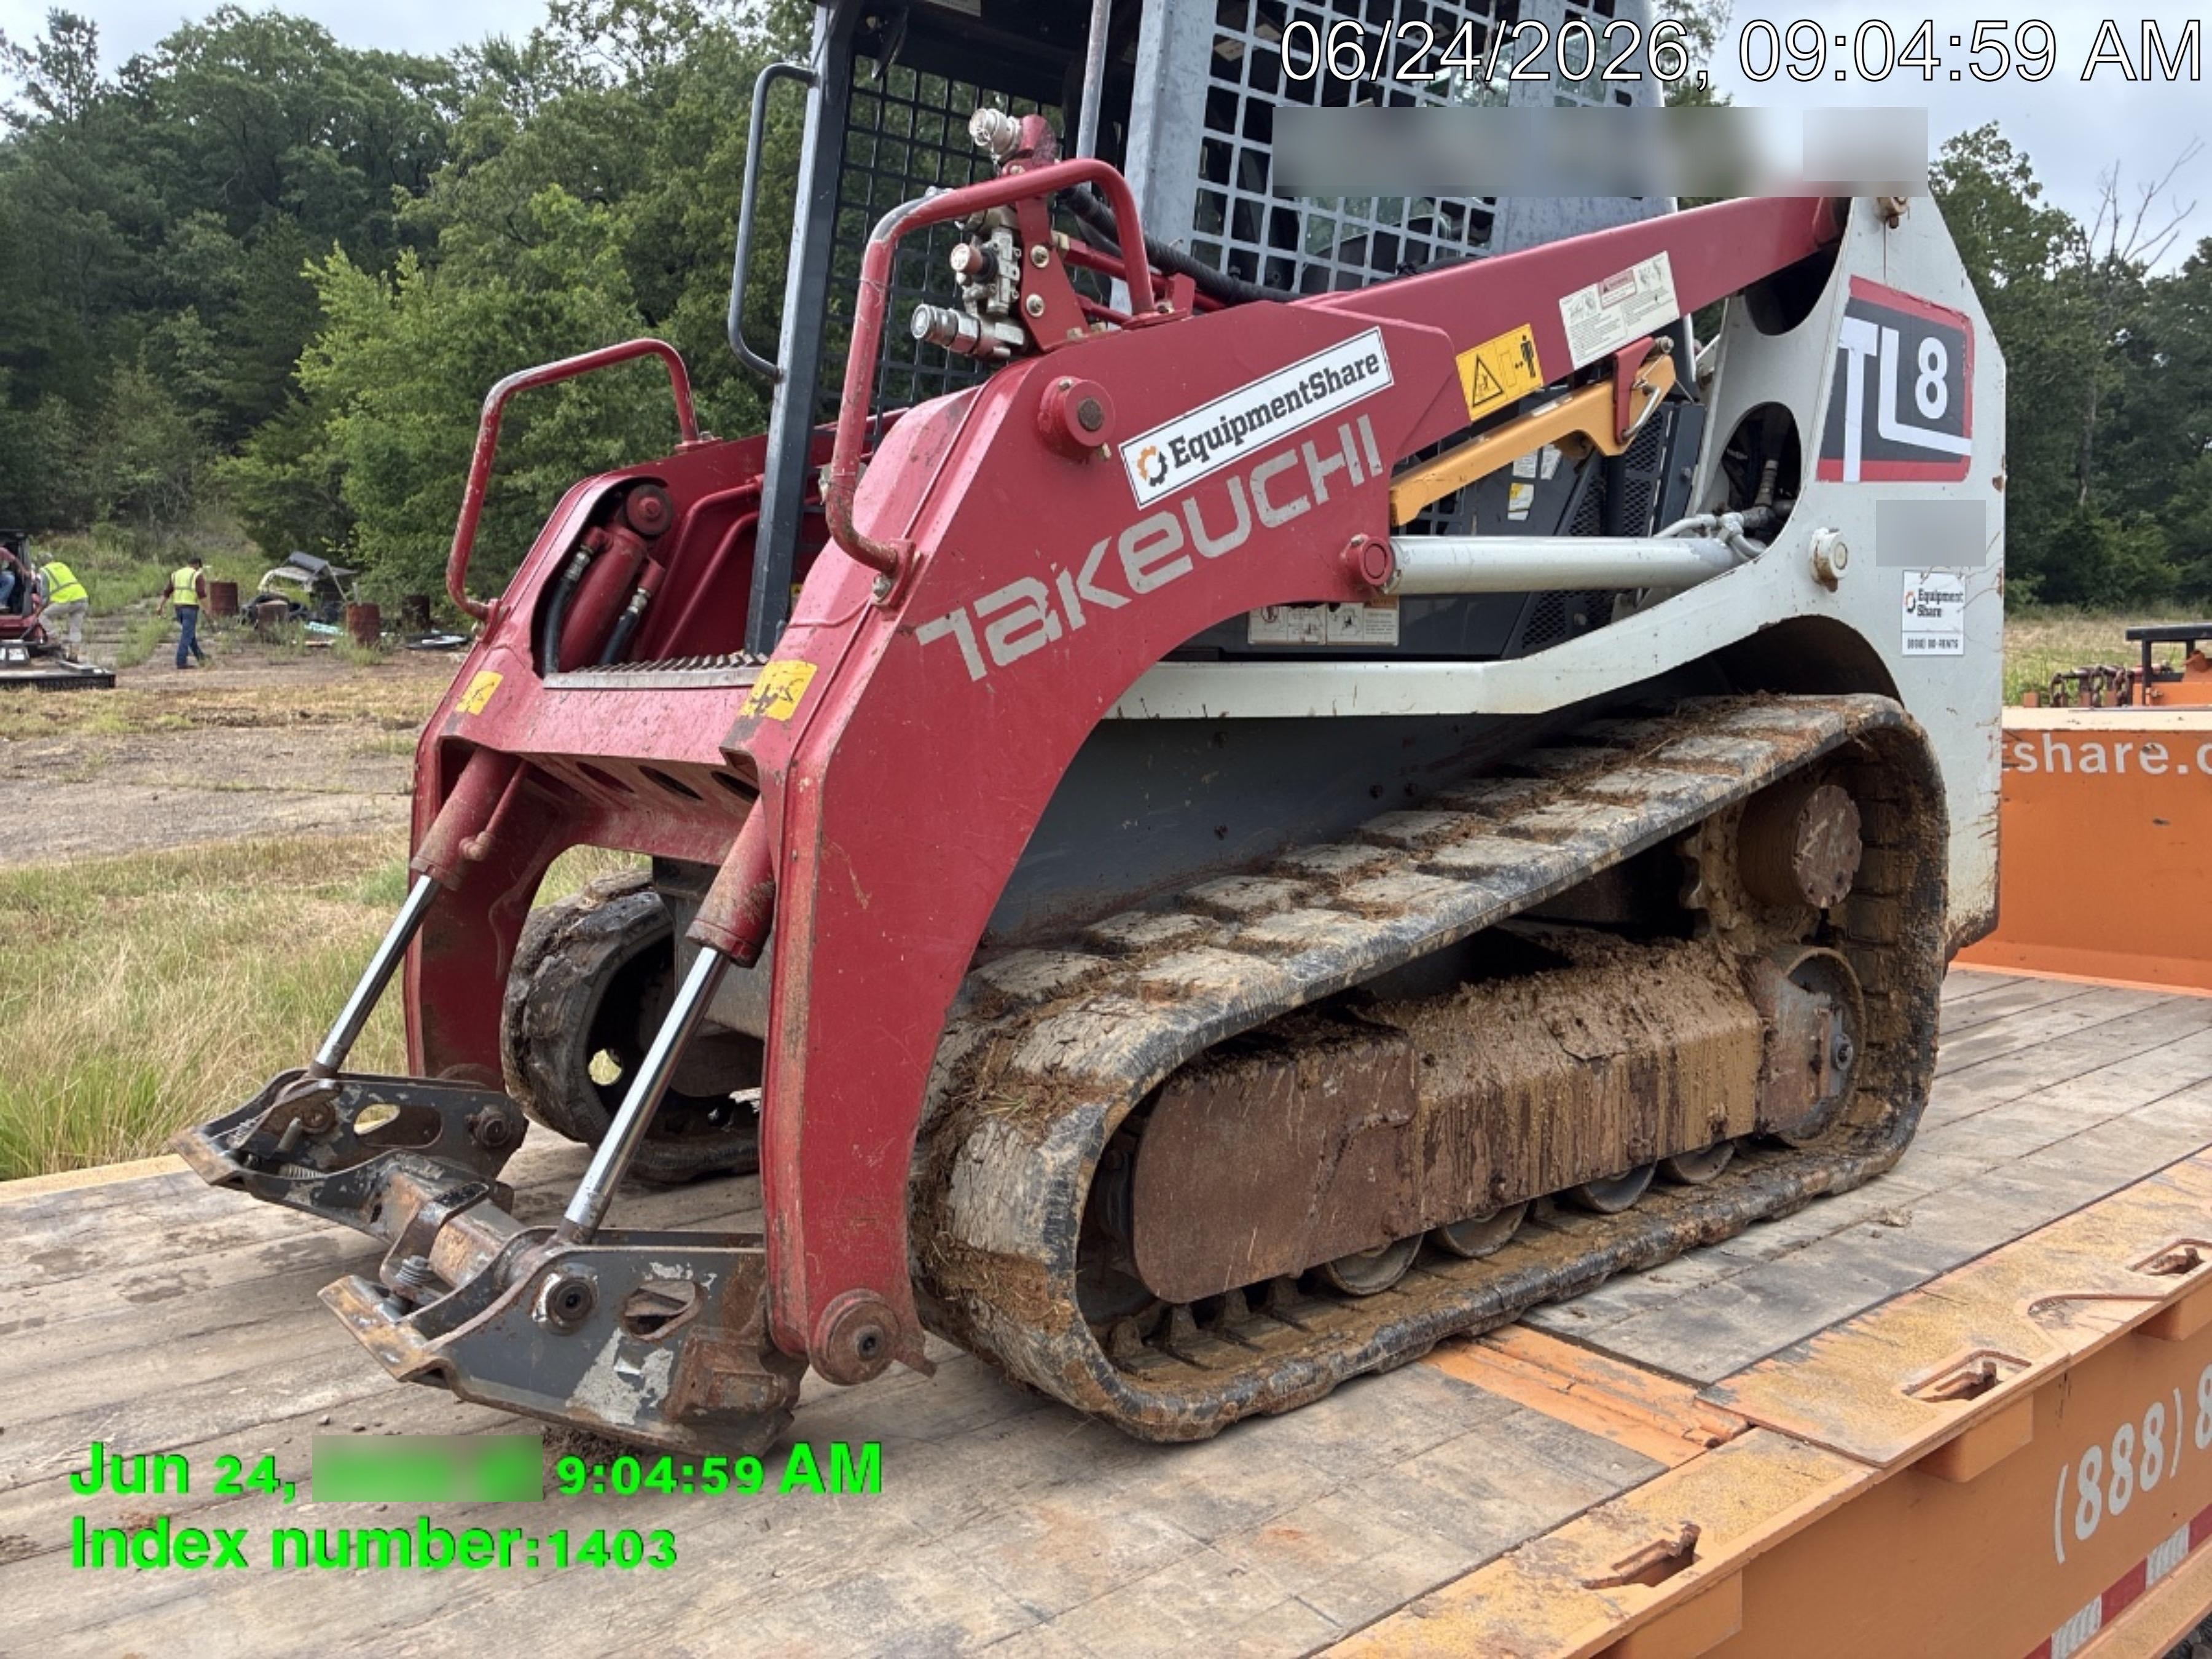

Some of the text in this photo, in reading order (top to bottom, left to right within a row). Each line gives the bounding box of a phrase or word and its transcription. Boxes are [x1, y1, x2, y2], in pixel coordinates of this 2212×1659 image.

[1168, 353, 1380, 468] EquipmentShare
[1838, 316, 1972, 482] TL8
[1917, 604, 1942, 618] Share
[1918, 588, 1964, 605] Equipment
[2054, 1387, 2183, 1564] (888)
